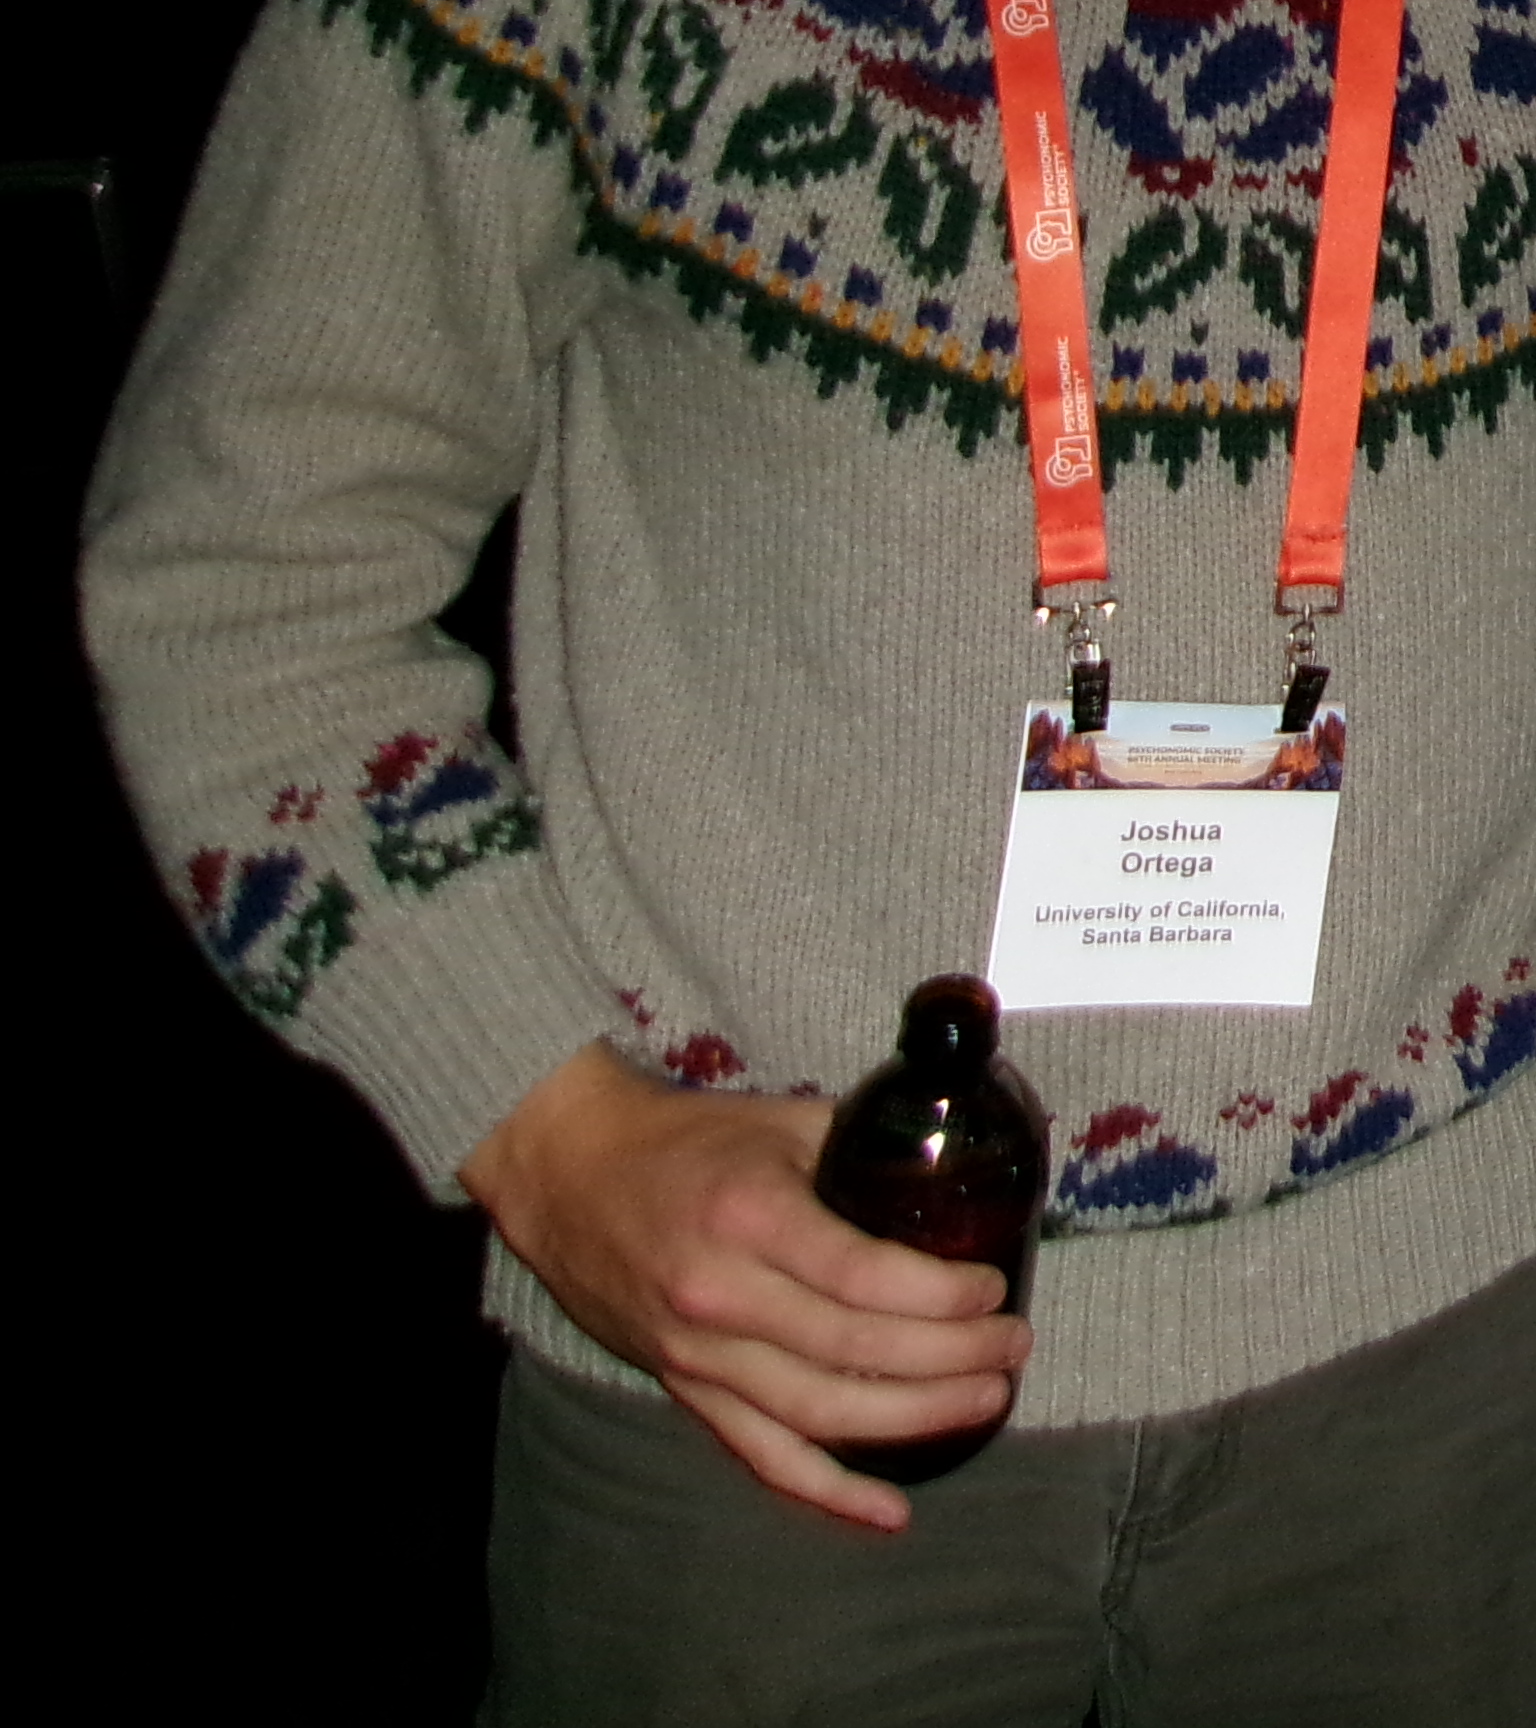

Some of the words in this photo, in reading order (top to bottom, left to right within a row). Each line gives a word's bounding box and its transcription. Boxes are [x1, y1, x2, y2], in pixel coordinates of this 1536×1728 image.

[1034, 110, 1055, 208] PSYCHONOMIC
[1057, 335, 1075, 433] PSYCHONOMIC
[1120, 819, 1223, 844] Joshua
[1120, 852, 1214, 878] Ortega
[1035, 902, 1143, 923] University
[1149, 900, 1173, 918] of
[1177, 899, 1286, 921] California,
[1081, 927, 1142, 945] Santa
[1148, 924, 1233, 943] Barbara
